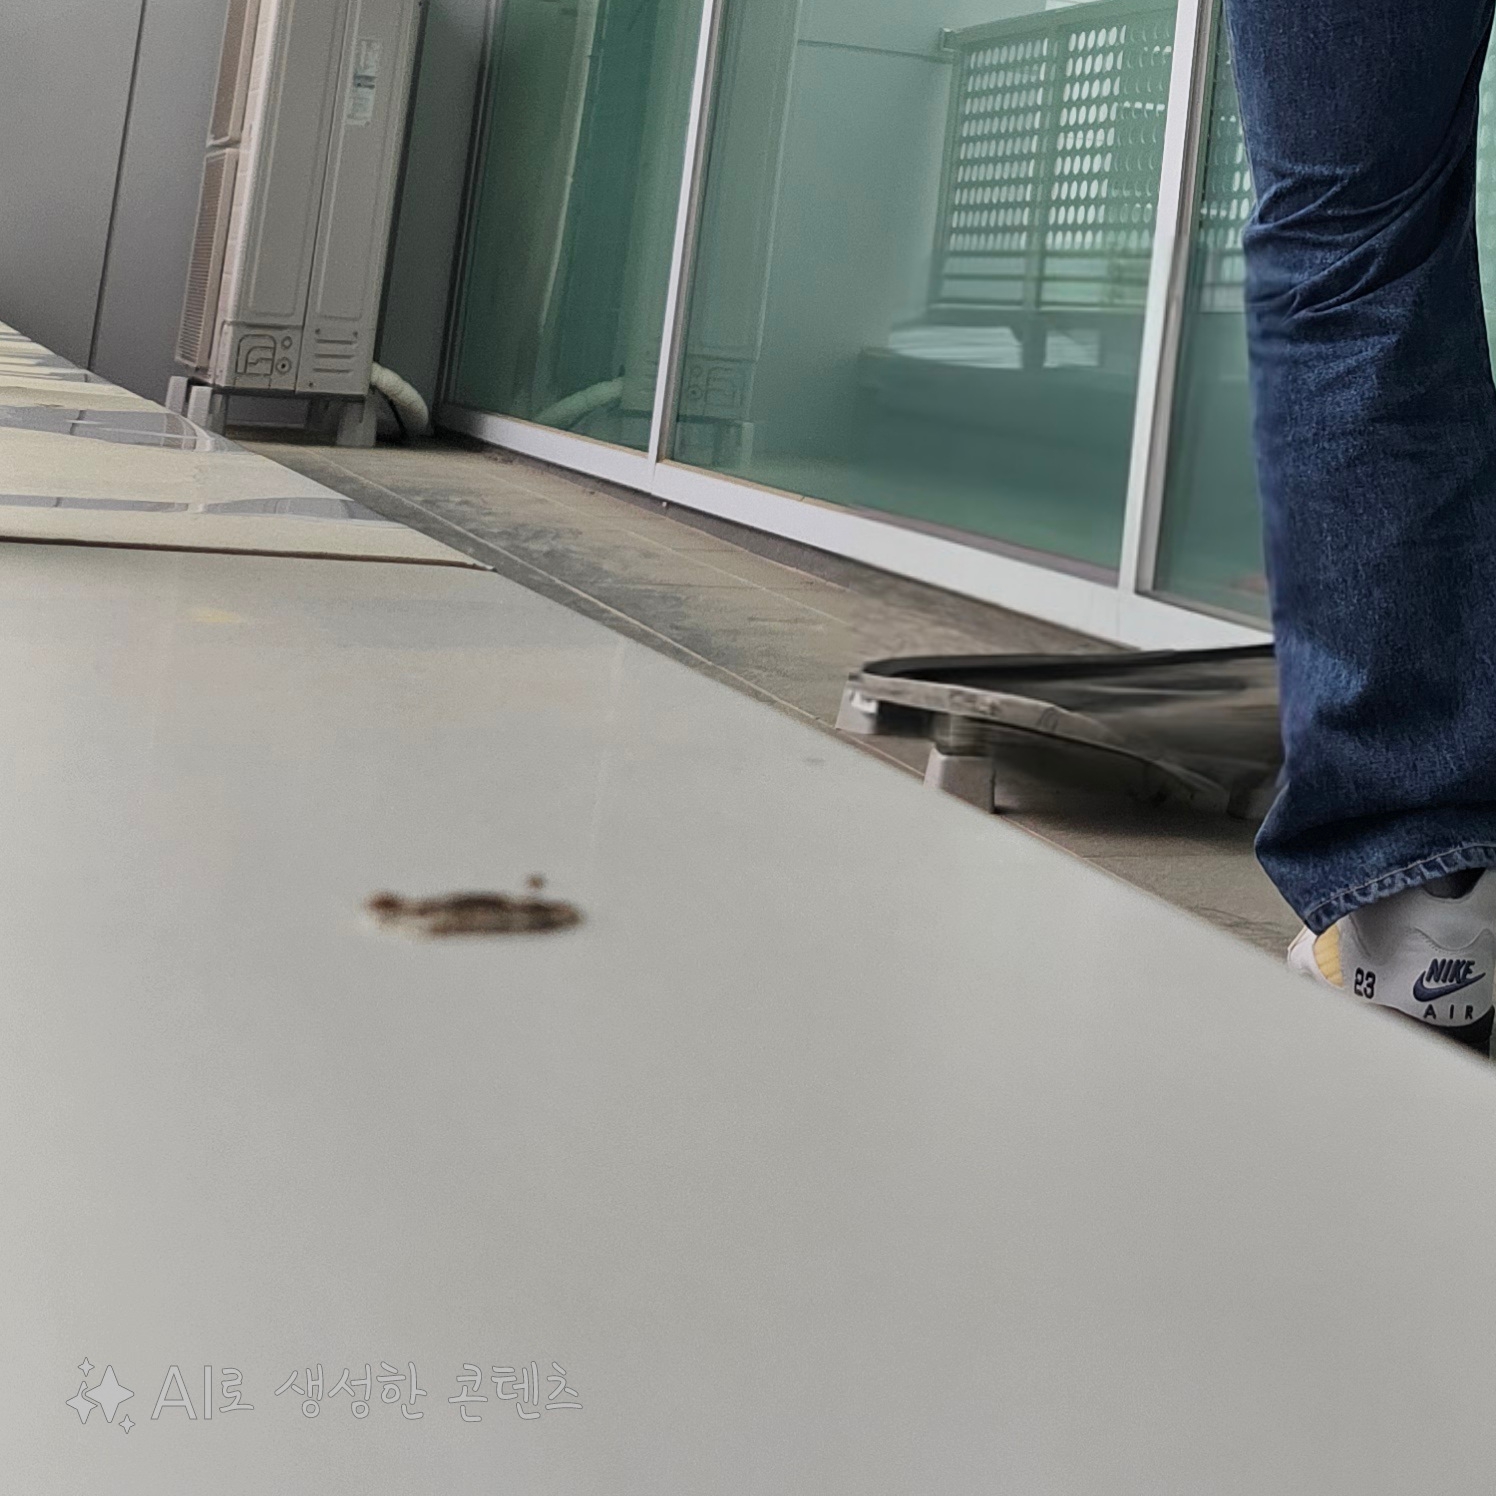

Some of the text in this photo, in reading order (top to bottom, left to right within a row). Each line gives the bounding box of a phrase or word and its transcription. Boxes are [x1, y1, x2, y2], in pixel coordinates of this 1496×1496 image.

[1354, 967, 1376, 999] 23
[1425, 957, 1476, 984] NIKE
[1423, 1003, 1473, 1020] AIR
